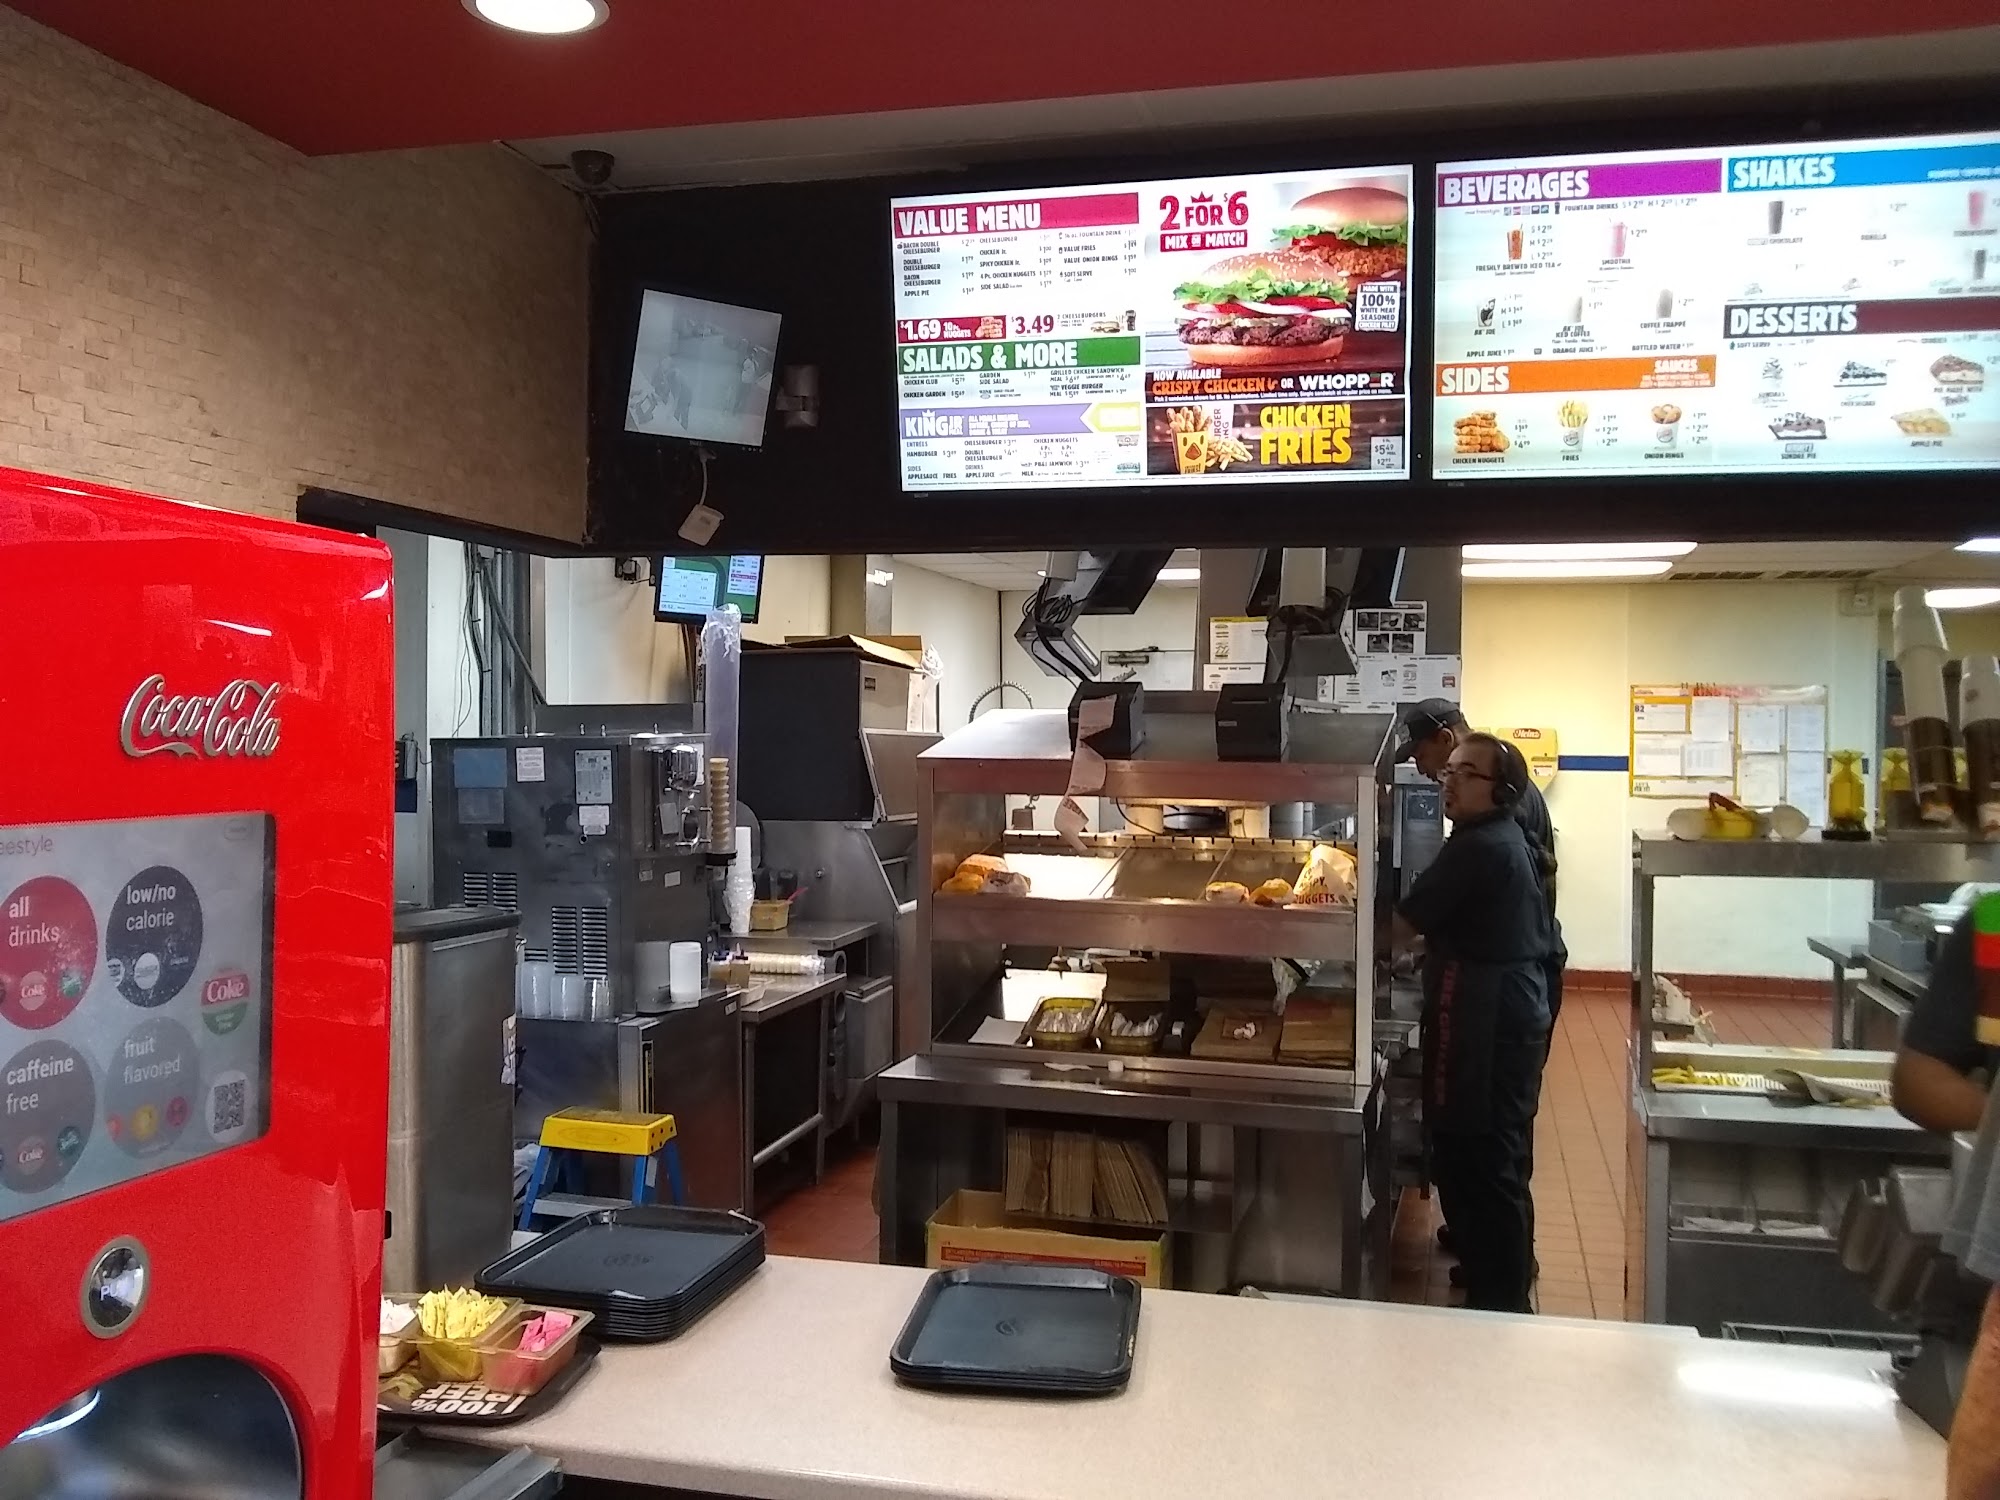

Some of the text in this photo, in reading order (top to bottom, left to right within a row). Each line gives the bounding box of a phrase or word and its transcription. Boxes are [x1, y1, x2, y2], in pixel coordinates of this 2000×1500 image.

[1733, 156, 1836, 189] SHAKES
[1444, 169, 1590, 205] BEVERAGES
[898, 202, 1041, 236] VALUE MENU
[1160, 195, 1180, 231] 2
[1185, 205, 1224, 227] FOR
[903, 247, 940, 255] CHEESEBURGER
[1165, 234, 1188, 250] MIX
[1205, 232, 1245, 248] MATCH
[1361, 294, 1396, 306] 100%
[1730, 304, 1857, 335] DESSERTS
[903, 340, 1078, 373] SALADS & MORE
[1152, 380, 1201, 396] CRISPY
[1203, 377, 1265, 394] CHICKEN
[1280, 377, 1294, 389] OR
[1153, 368, 1222, 381] NOW AVAILABLE
[1441, 365, 1510, 394] SIDES
[904, 410, 949, 437] KING
[1260, 404, 1351, 430] CHICKEN
[1260, 428, 1352, 465] FRIES
[1665, 451, 1684, 459] RINGS
[1452, 456, 1505, 465] CHICKEN NUGGETS
[127, 884, 177, 905] low/no
[9, 896, 30, 918] all
[126, 908, 175, 931] calorie
[9, 922, 60, 947] drinks
[207, 979, 245, 1003] Coke
[125, 1036, 155, 1059] fruit
[7, 1057, 74, 1086] caffeine
[124, 1054, 182, 1084] flavored
[6, 1092, 39, 1115] free
[411, 1399, 498, 1416] 100%
